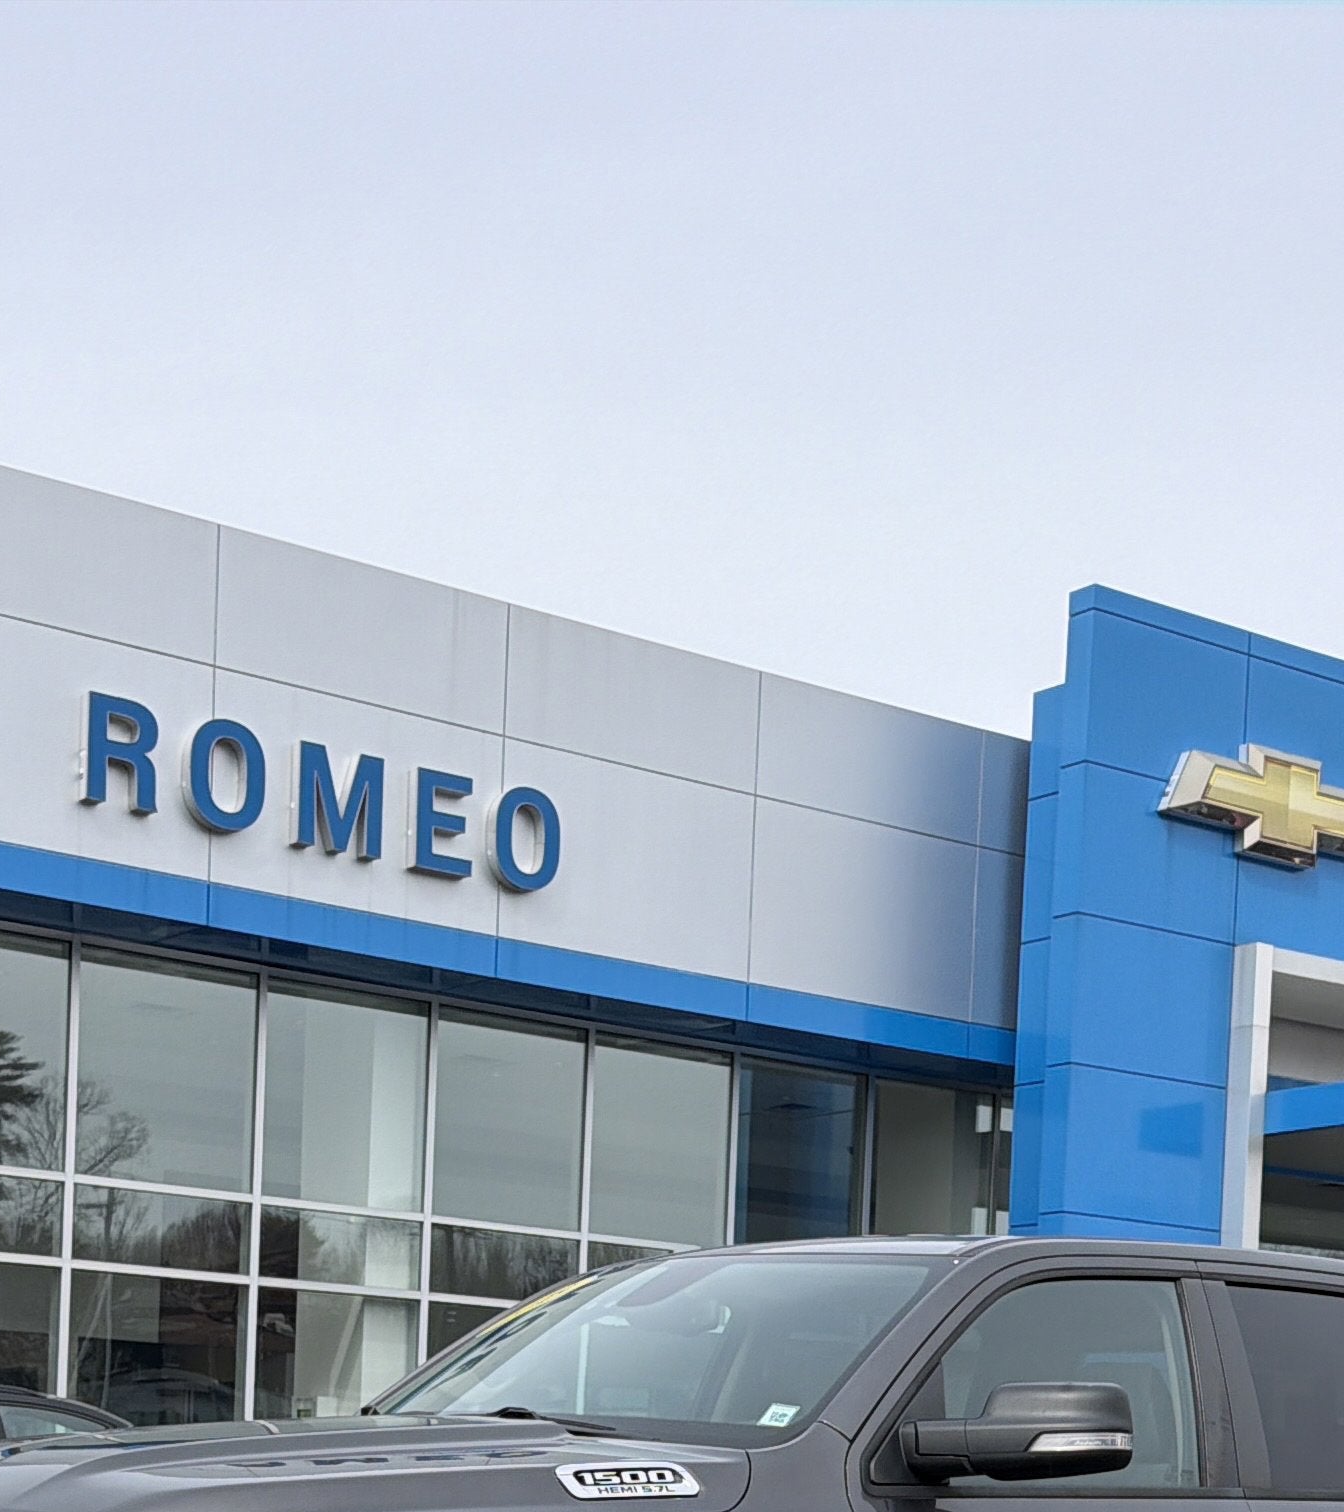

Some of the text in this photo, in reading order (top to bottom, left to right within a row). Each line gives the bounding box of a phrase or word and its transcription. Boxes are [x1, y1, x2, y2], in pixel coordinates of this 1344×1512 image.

[80, 690, 561, 893] ROMEO
[577, 1470, 674, 1485] 1500
[597, 1485, 676, 1495] HEMI 5.7L
